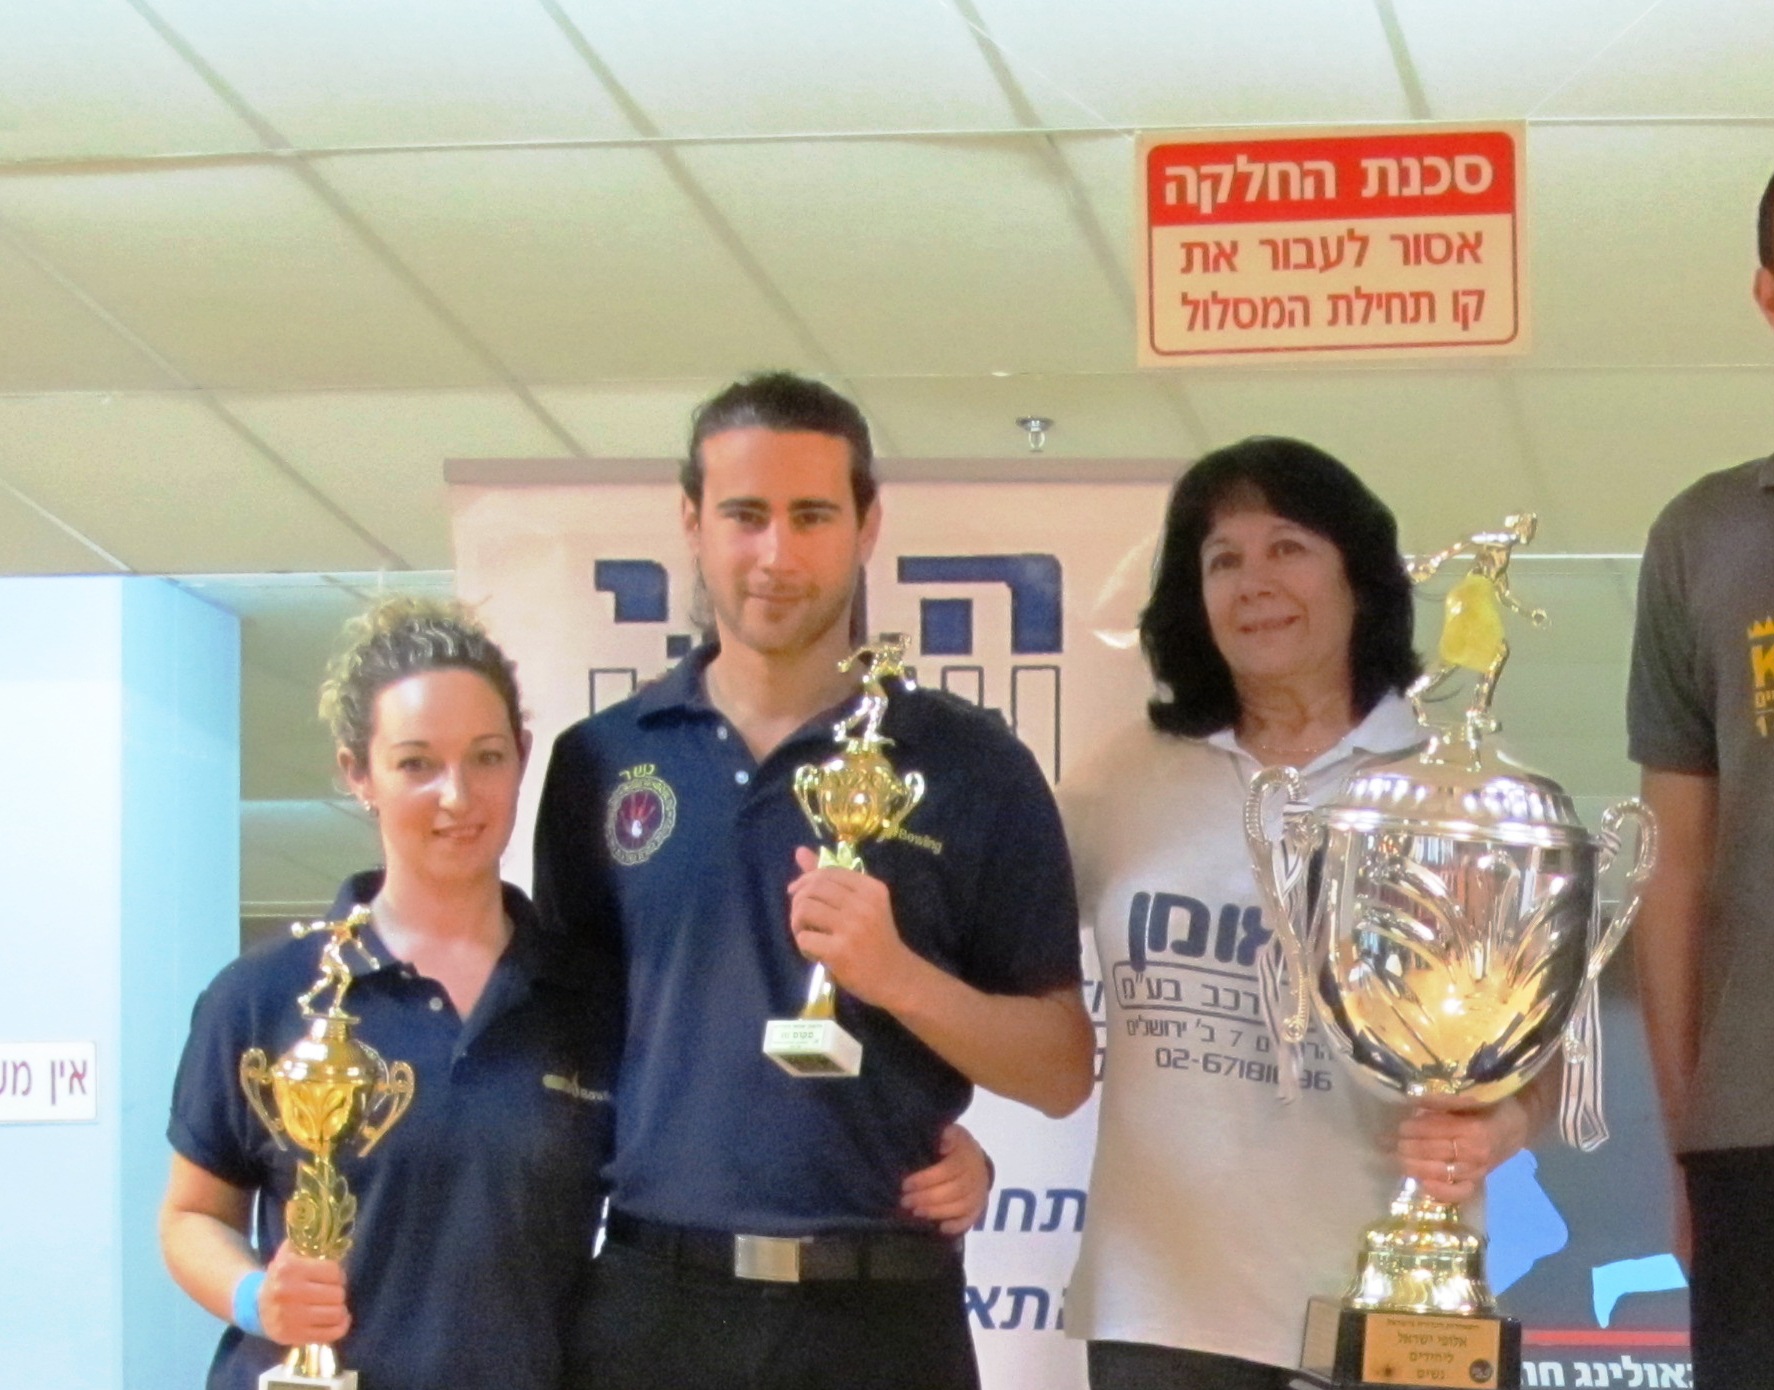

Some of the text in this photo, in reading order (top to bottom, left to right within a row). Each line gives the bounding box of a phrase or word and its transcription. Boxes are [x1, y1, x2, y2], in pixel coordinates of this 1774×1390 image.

[1165, 154, 1493, 214] סכנת החלקה
[1180, 228, 1483, 274] אסור לעבור את
[1181, 286, 1485, 331] קו תחילת המסלול
[50, 1060, 88, 1105] אין
[1573, 1355, 1694, 1388] אולינג
